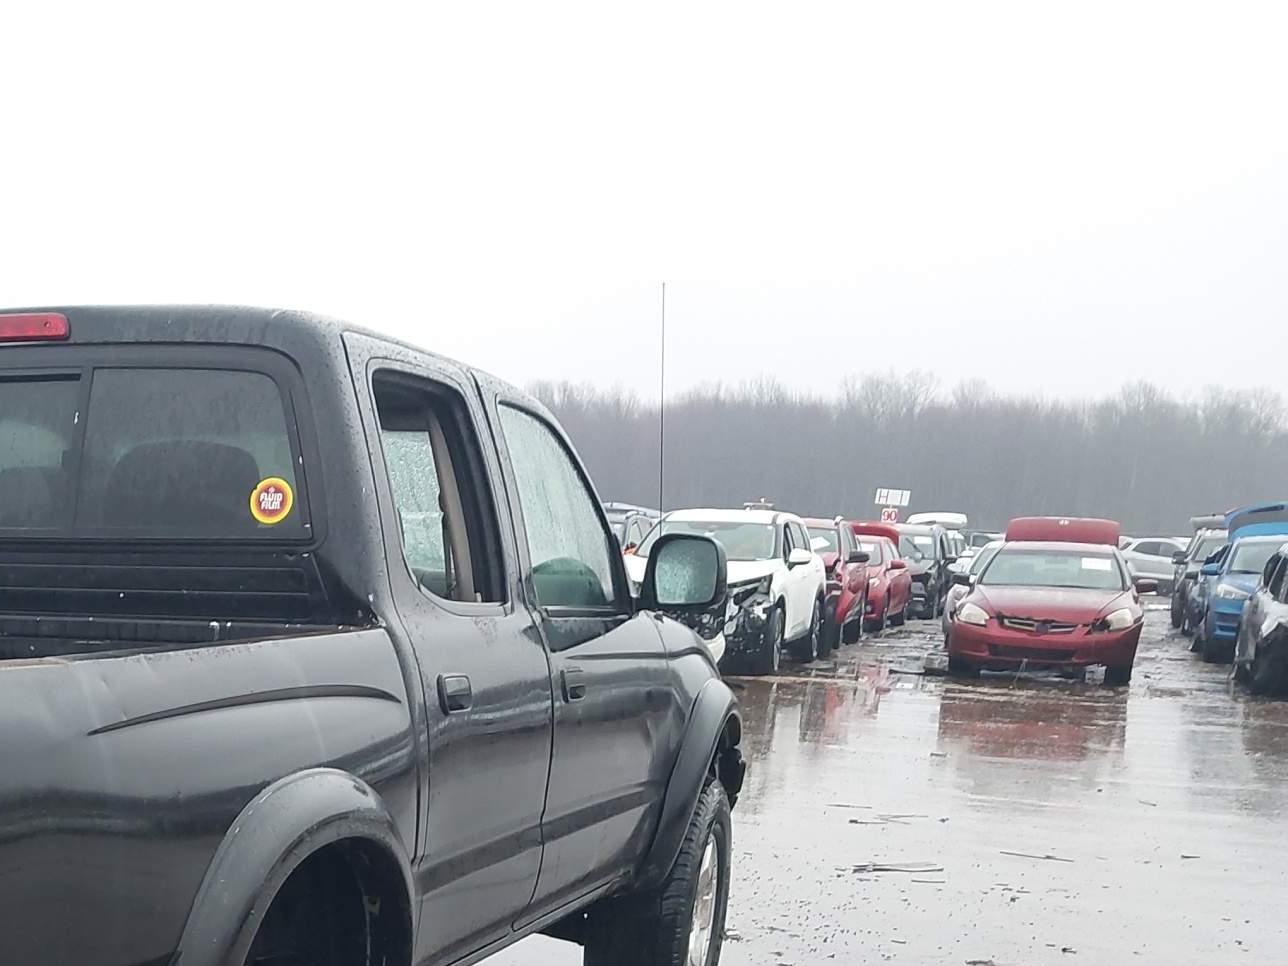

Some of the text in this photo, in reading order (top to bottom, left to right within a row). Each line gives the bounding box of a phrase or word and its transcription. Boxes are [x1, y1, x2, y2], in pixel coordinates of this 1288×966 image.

[259, 492, 283, 502] FLUID
[260, 501, 281, 510] FILM
[882, 510, 898, 521] 90
